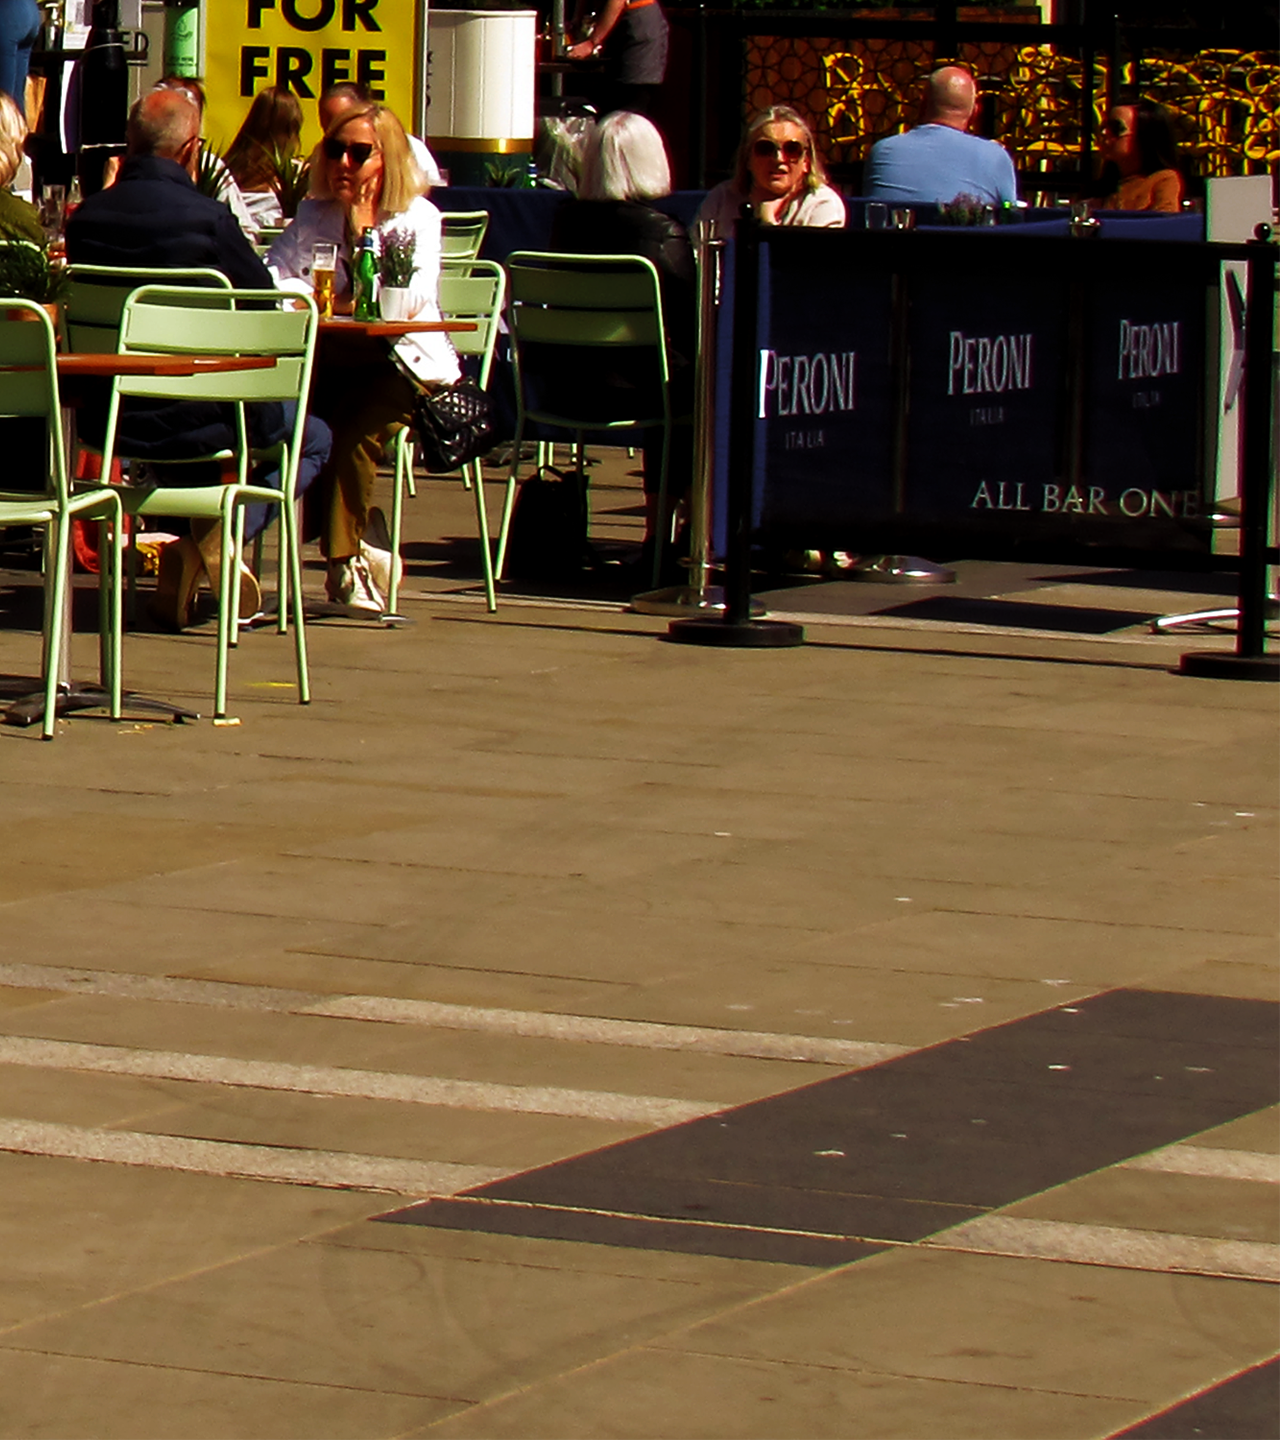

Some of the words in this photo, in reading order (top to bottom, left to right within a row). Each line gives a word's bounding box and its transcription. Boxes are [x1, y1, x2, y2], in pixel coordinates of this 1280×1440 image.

[240, 46, 386, 101] FREE
[946, 330, 1035, 397] PERONI
[1116, 318, 1182, 381] PERONI
[757, 348, 857, 419] PERONI
[784, 429, 826, 451] ITALIA
[968, 479, 1031, 512] ALL
[1040, 483, 1109, 516] BAR
[1118, 487, 1201, 519] ONE
